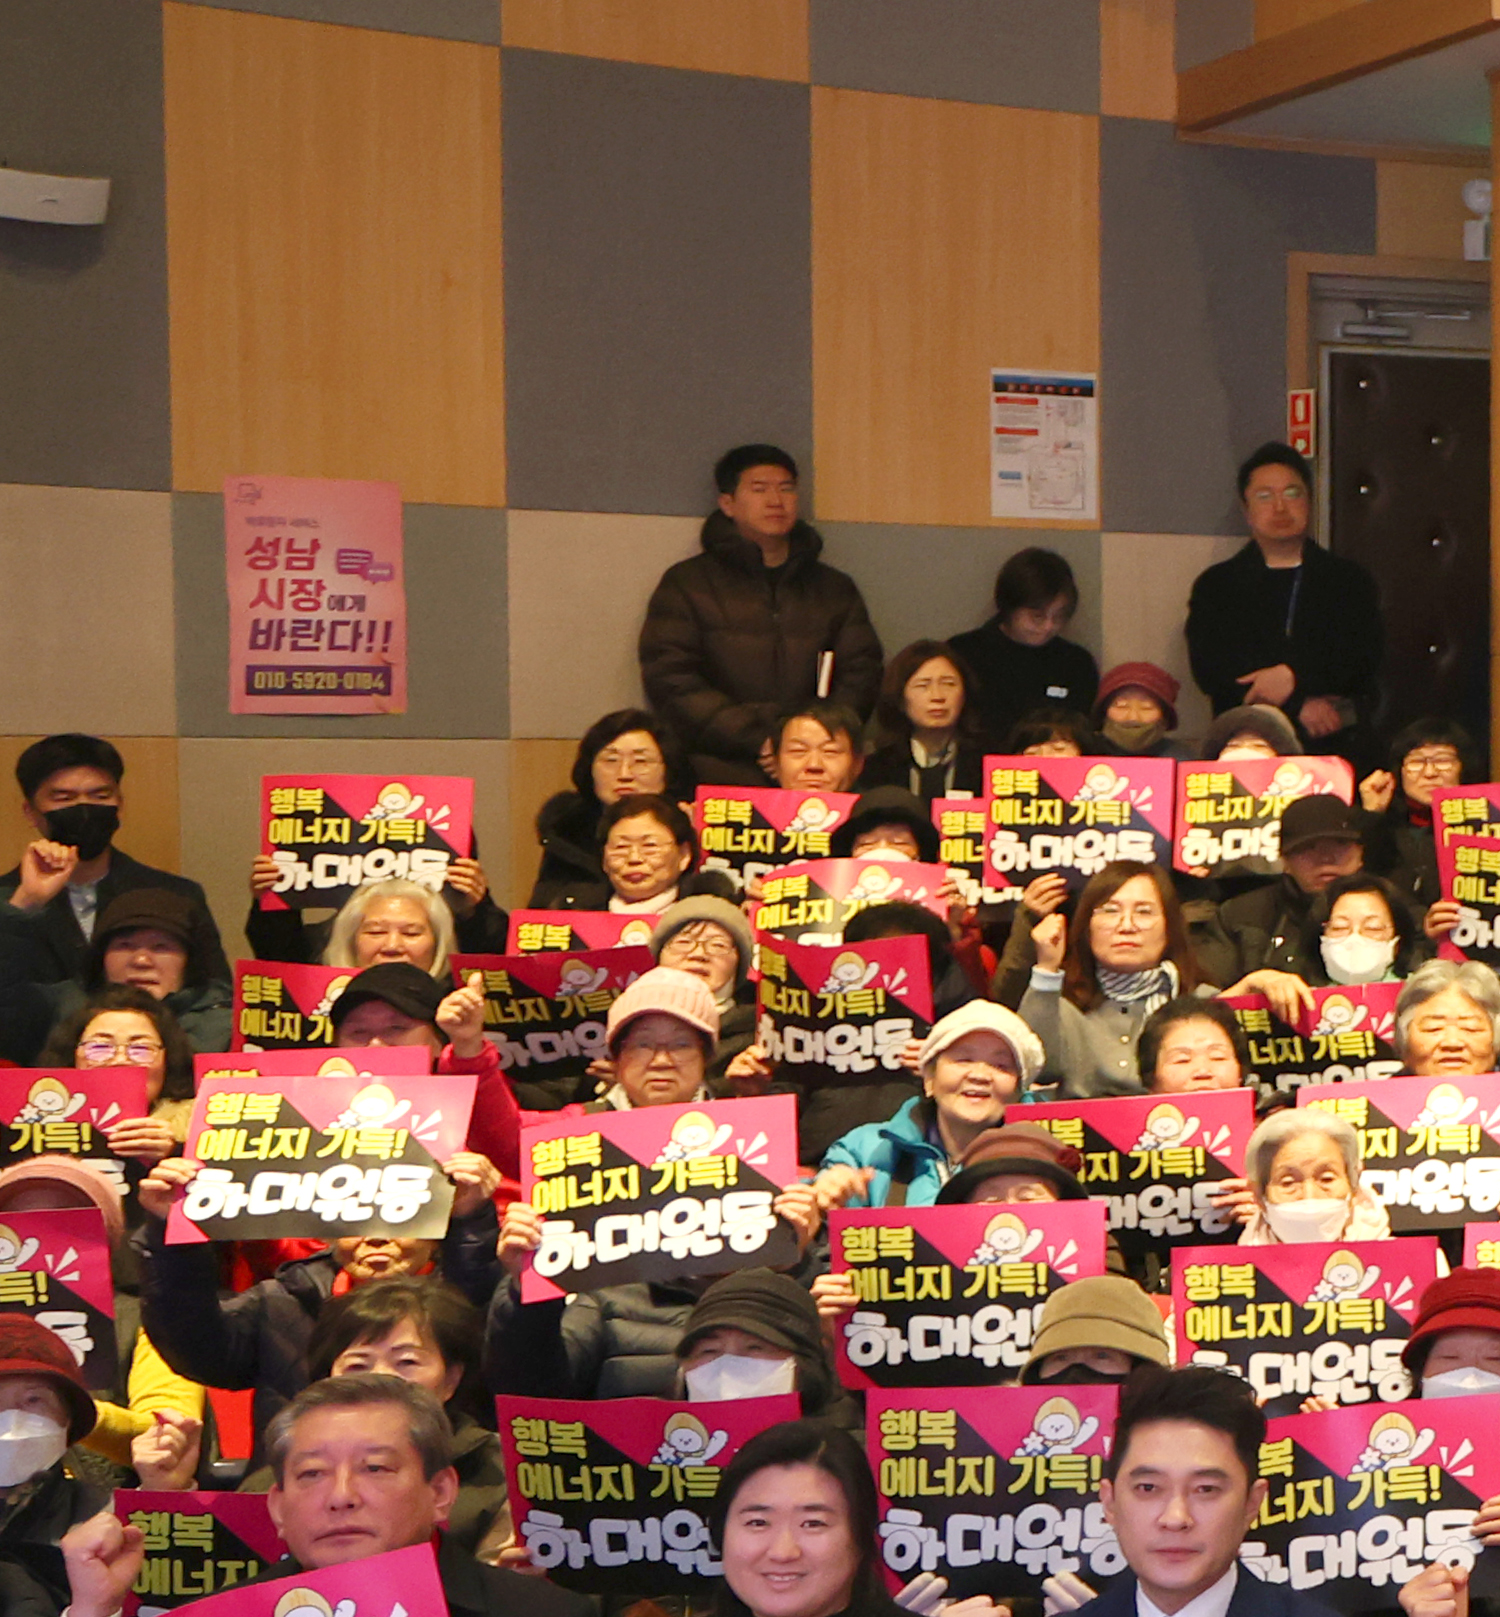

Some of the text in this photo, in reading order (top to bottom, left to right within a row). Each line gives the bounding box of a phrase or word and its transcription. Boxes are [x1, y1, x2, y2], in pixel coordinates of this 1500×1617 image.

[245, 536, 321, 571] 성남
[249, 618, 393, 653] 바란다!!
[205, 1092, 284, 1125] 행복
[195, 1126, 409, 1162] 에너지 가득!
[530, 1131, 602, 1178] 행복
[182, 1164, 434, 1224] 하대원동
[530, 1154, 740, 1215] 에너지 가득!
[530, 1191, 777, 1277] 하대원동
